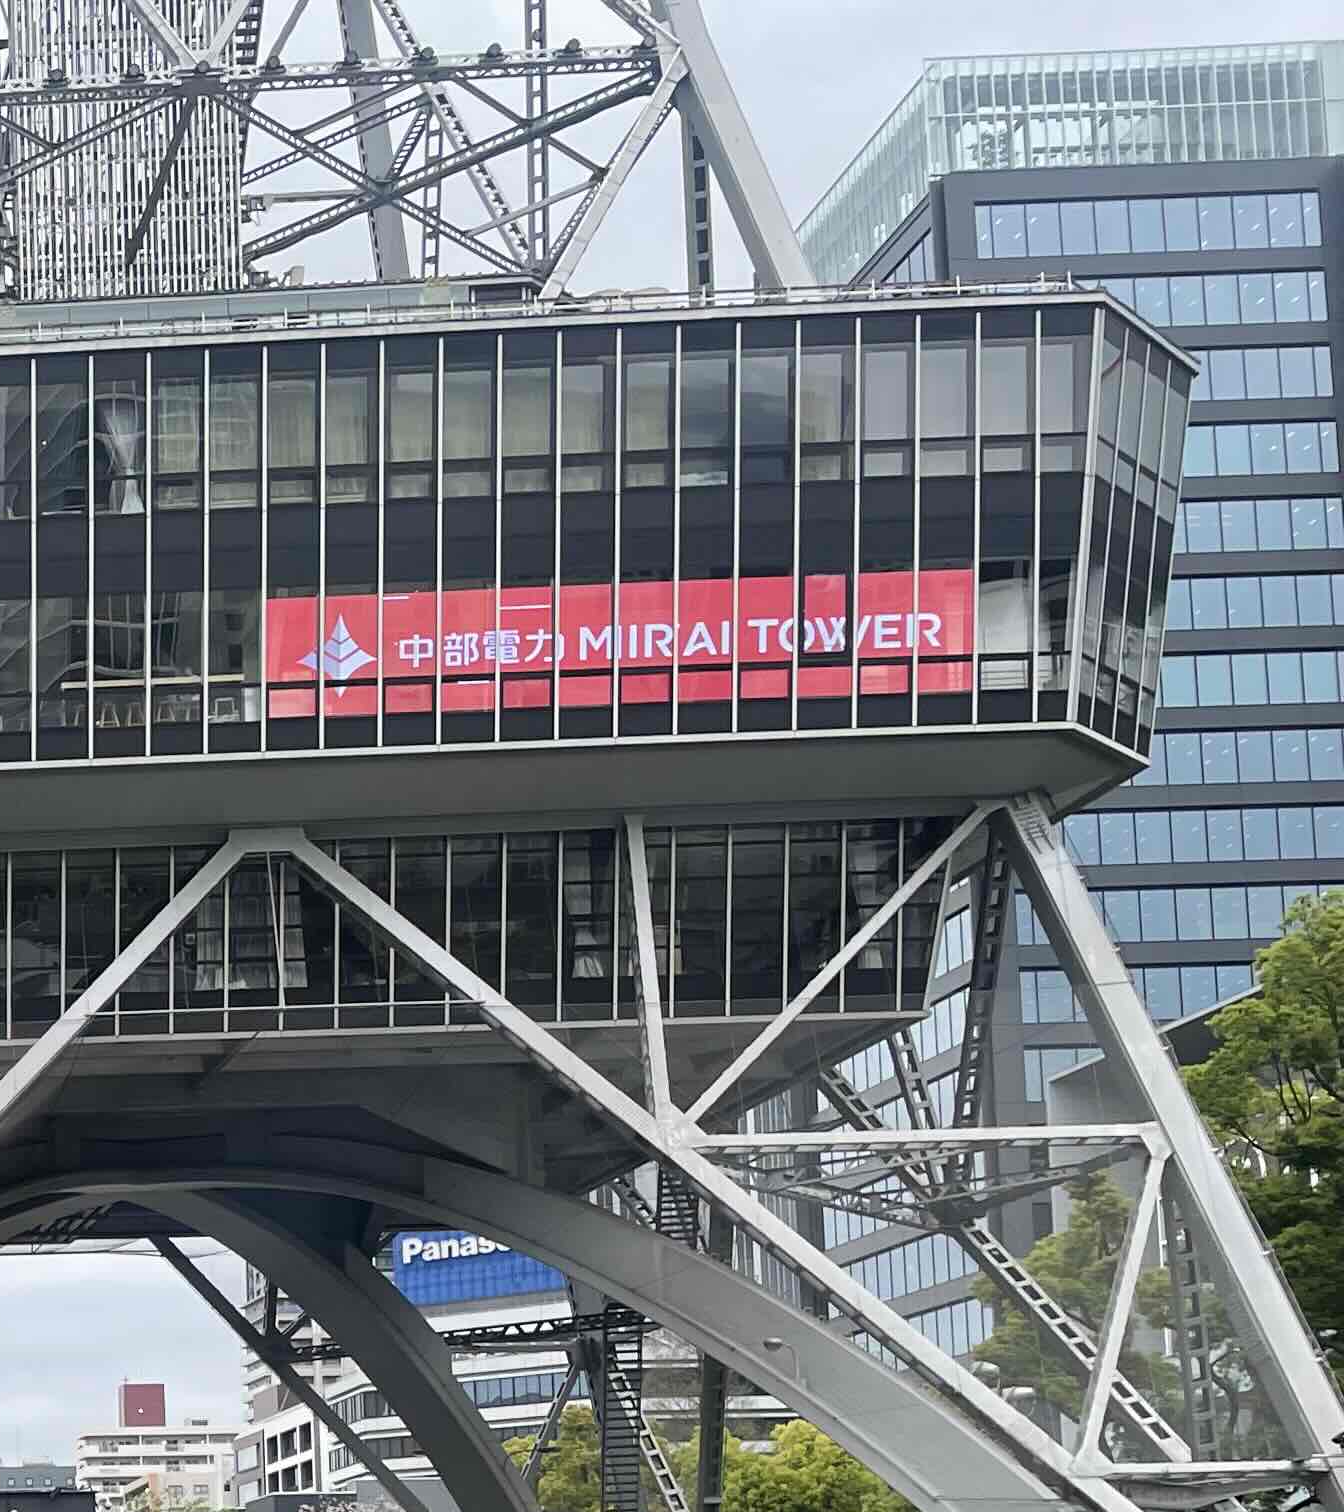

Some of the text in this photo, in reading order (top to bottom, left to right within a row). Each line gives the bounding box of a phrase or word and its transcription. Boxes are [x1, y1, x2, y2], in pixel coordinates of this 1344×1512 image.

[399, 612, 943, 668] 中部電力 MIRAI TOWER
